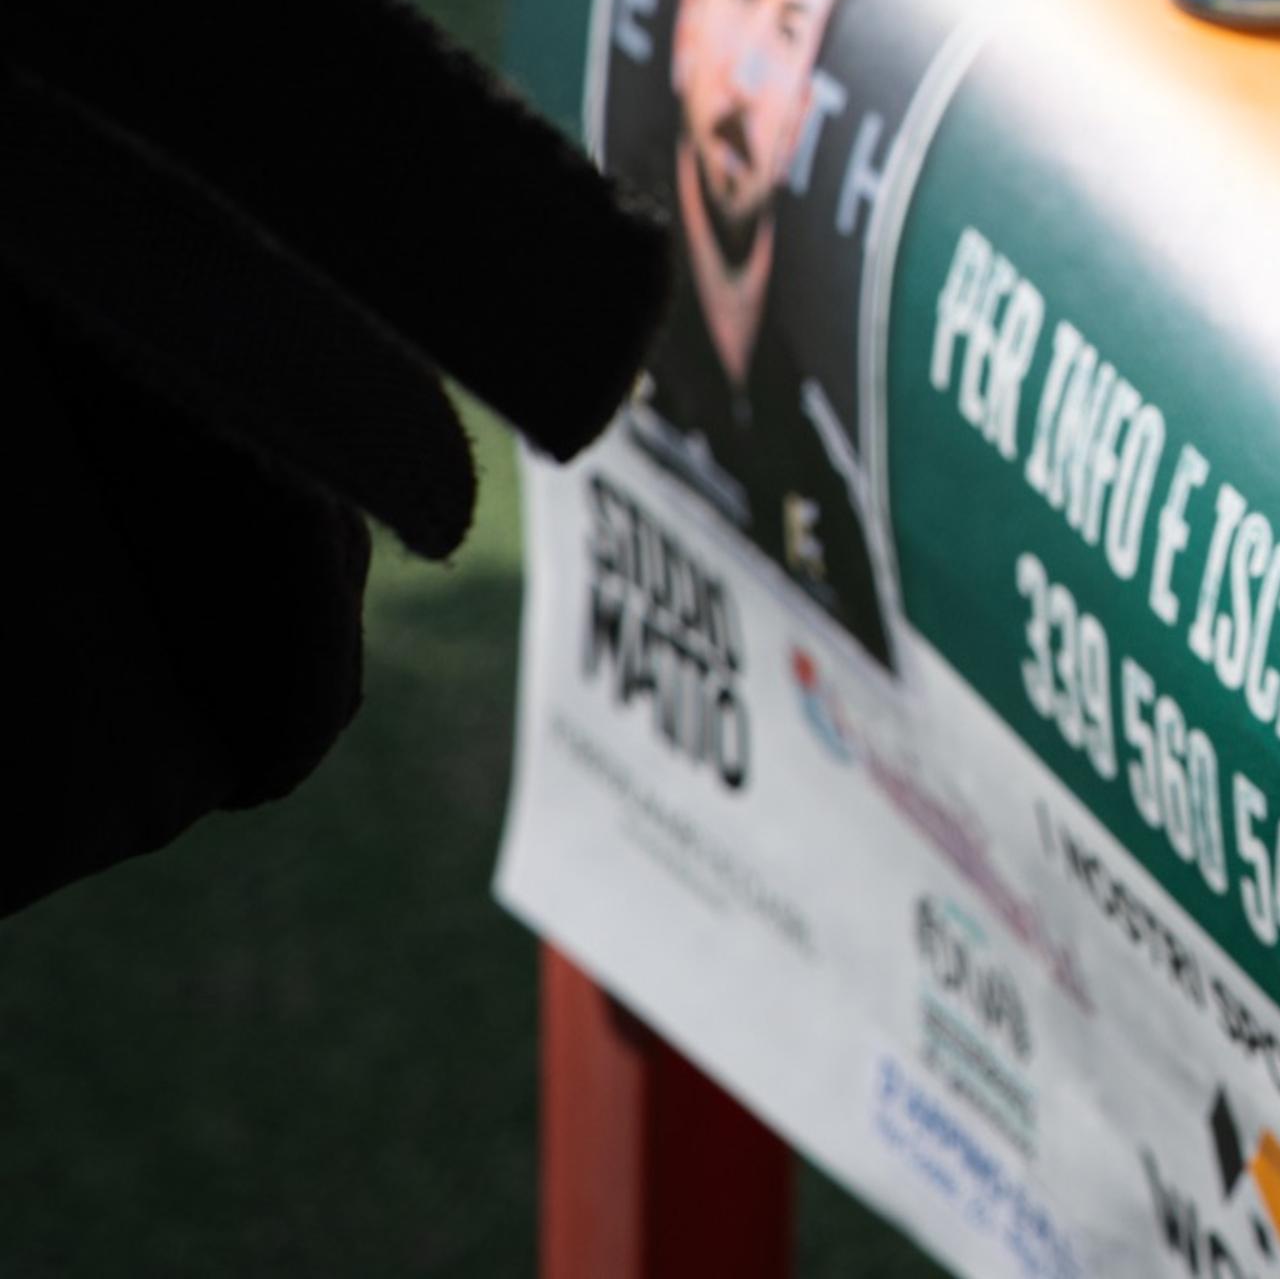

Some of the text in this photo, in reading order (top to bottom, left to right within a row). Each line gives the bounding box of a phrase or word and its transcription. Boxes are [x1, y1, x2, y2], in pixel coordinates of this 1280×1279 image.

[930, 225, 1046, 461] PER
[1024, 319, 1167, 580] INFO
[1148, 442, 1211, 626] E
[1015, 552, 1118, 782] 339
[1120, 654, 1229, 896] 560
[1059, 823, 1208, 1013] NOSTRI
